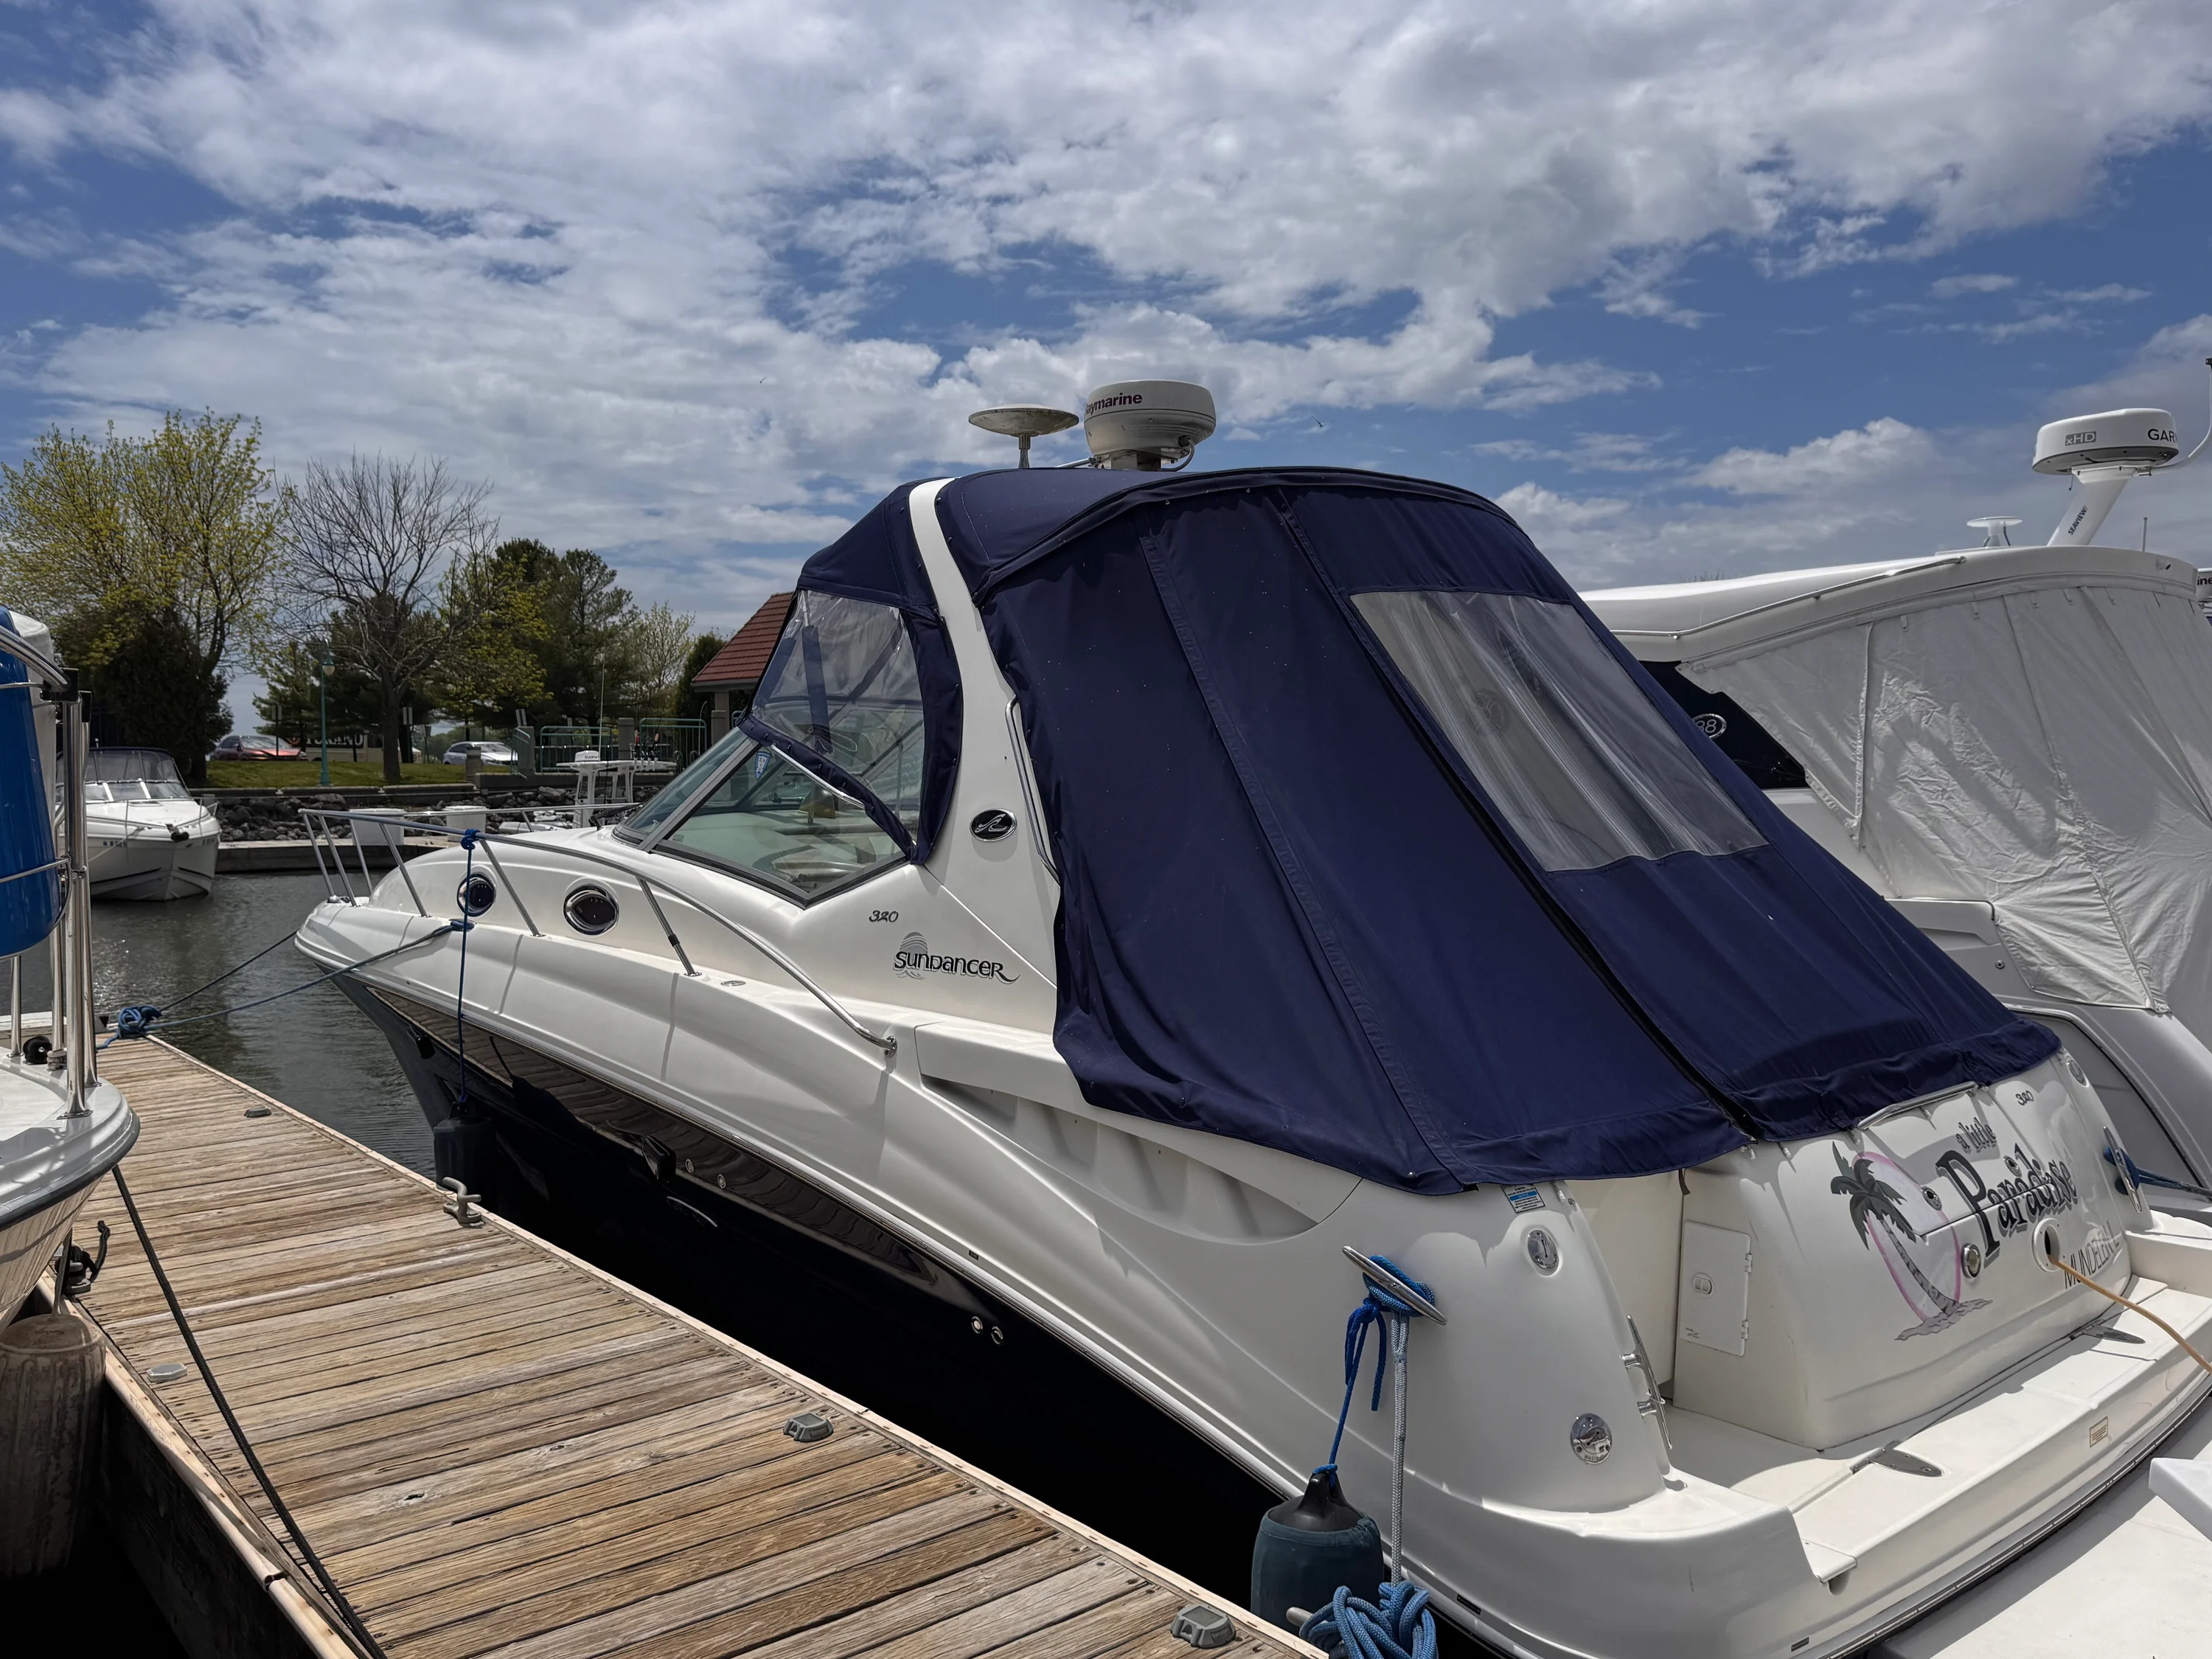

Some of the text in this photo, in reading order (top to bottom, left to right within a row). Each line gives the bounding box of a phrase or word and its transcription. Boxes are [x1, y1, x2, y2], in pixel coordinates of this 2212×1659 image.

[2066, 432, 2096, 445] xHD
[2067, 507, 2087, 535] SEAVIEW
[869, 910, 899, 922] 320
[2015, 1091, 2034, 1106] 320
[1935, 1143, 2079, 1264] Paradise
